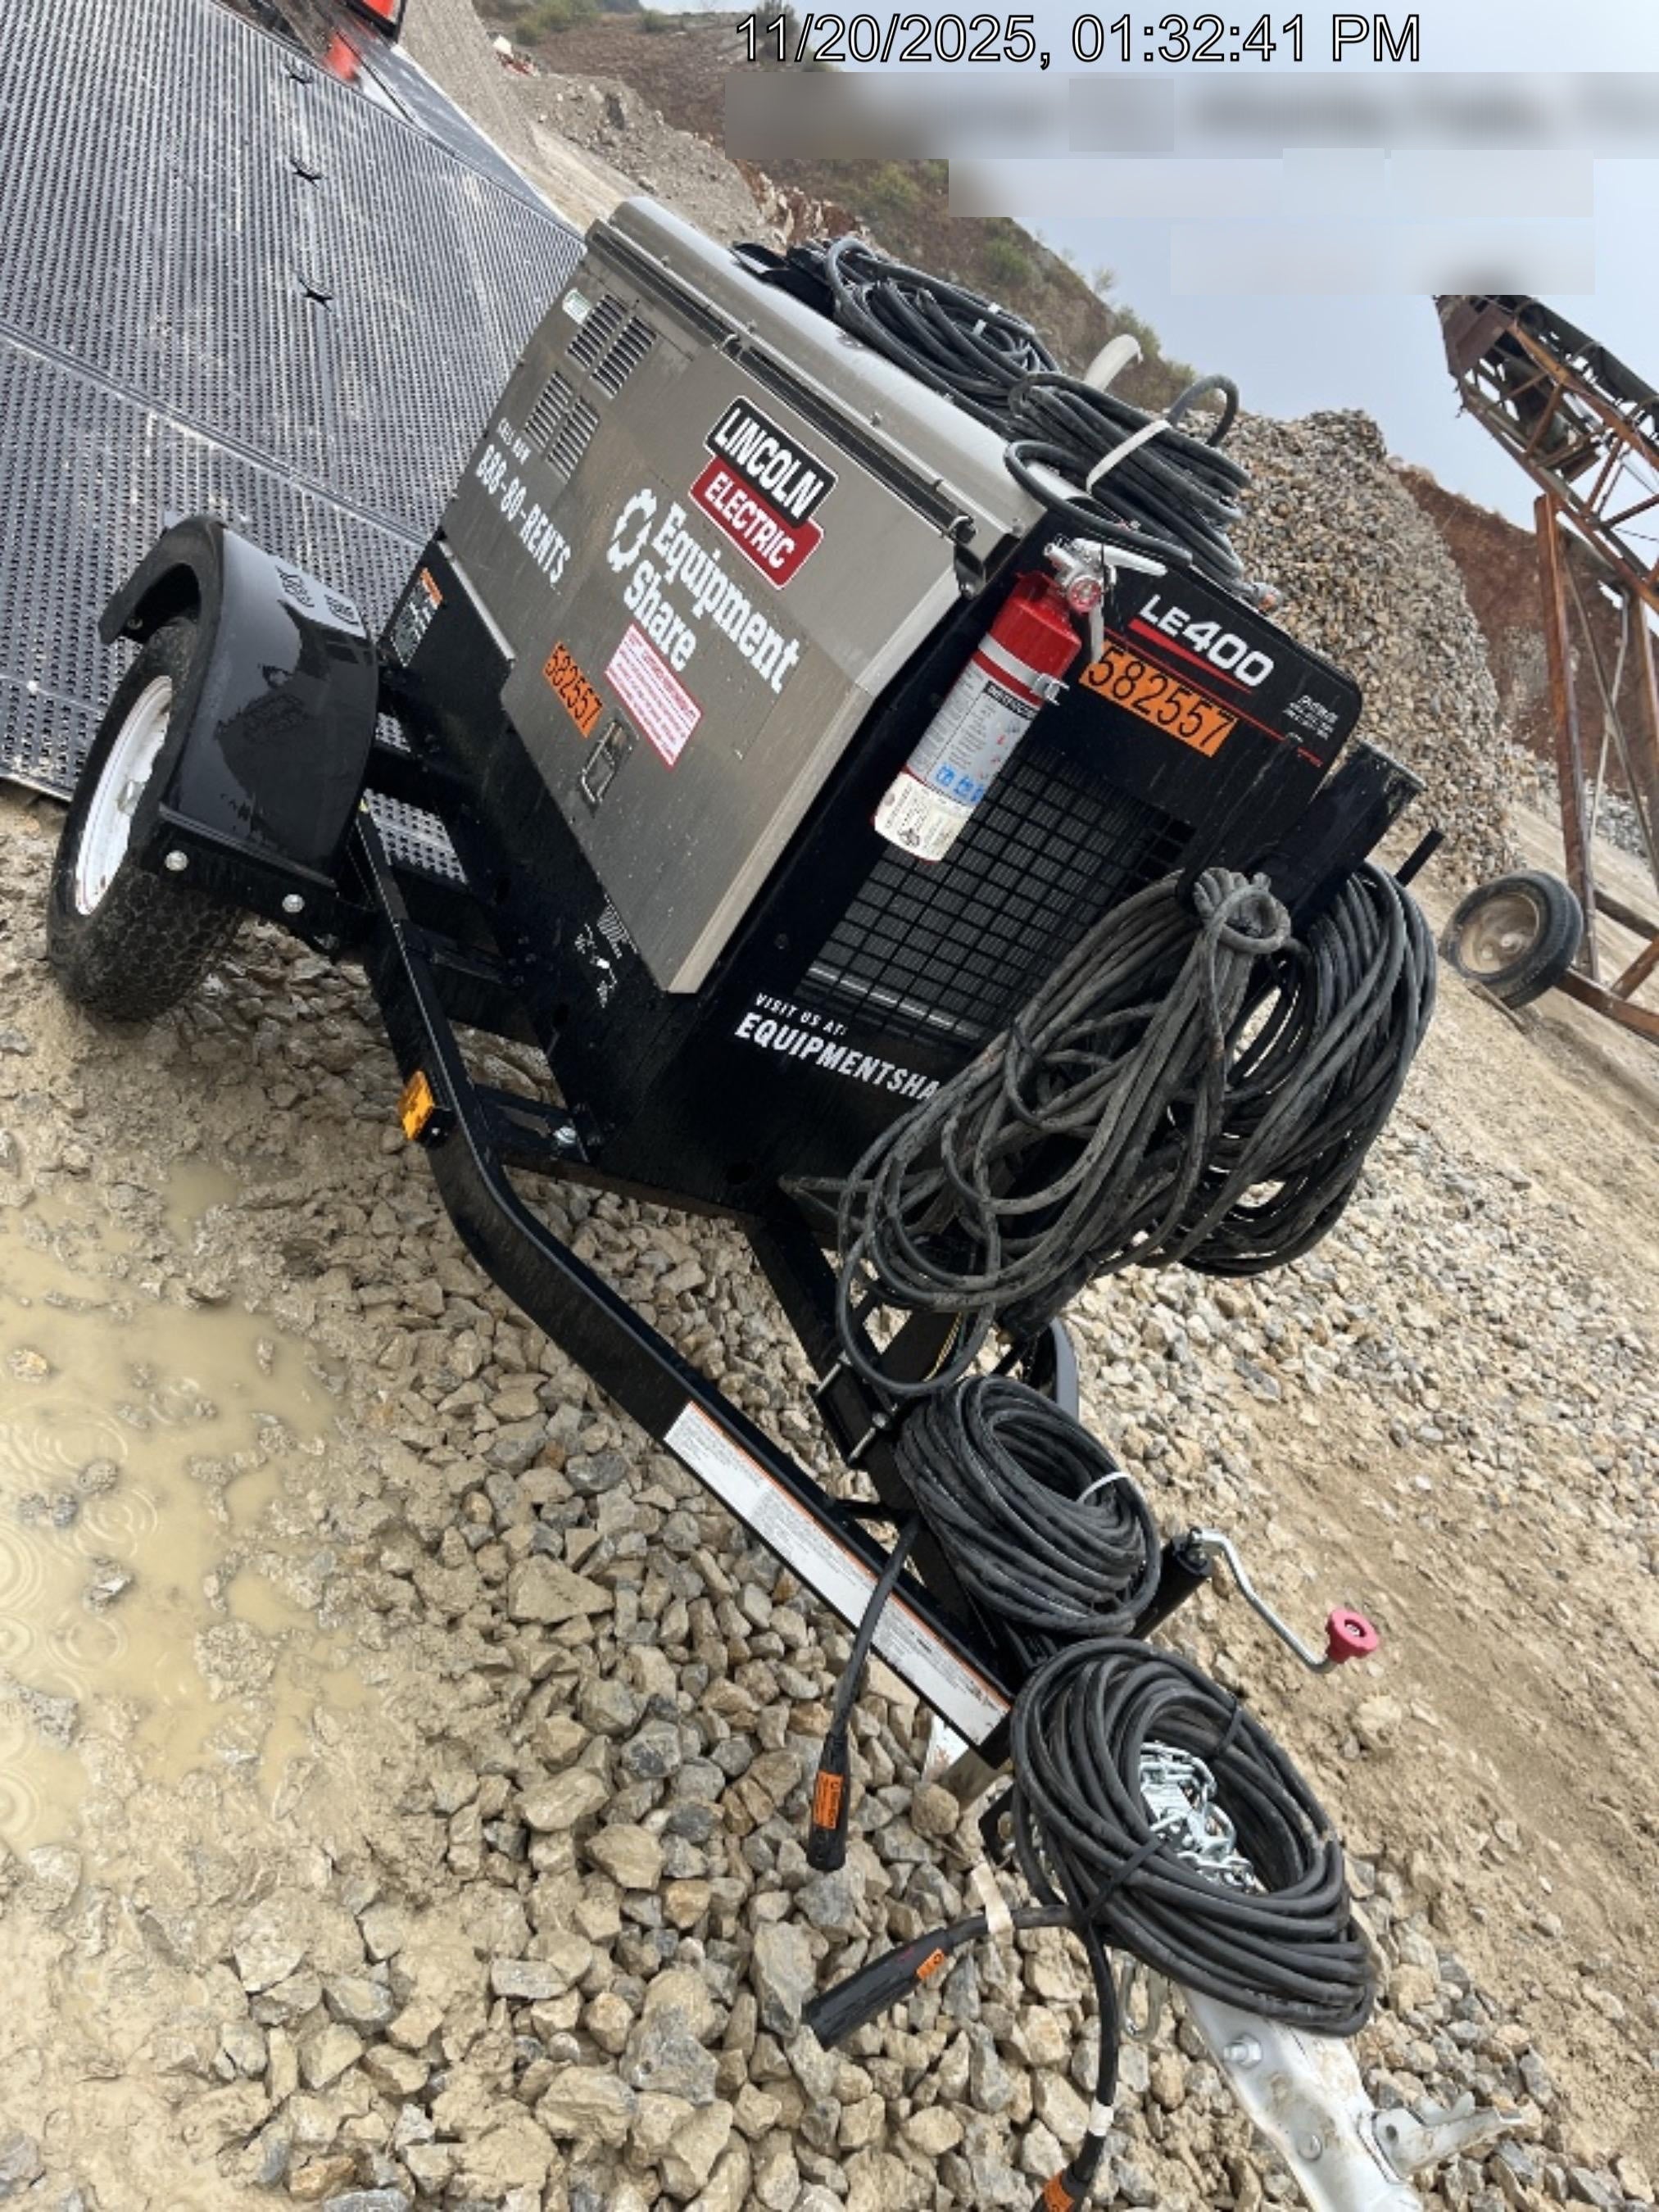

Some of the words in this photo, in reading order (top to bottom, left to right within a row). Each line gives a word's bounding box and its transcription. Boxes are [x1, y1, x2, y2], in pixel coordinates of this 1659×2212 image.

[714, 407, 824, 519] LINCOLN
[704, 470, 796, 569] ELECTRIC
[623, 559, 696, 672] Share
[651, 501, 800, 694] Equipment
[1139, 593, 1275, 687] LE400
[545, 643, 603, 728] 582557
[1088, 646, 1235, 748] 582557
[755, 992, 800, 1018] VISIT
[800, 1010, 822, 1027] US
